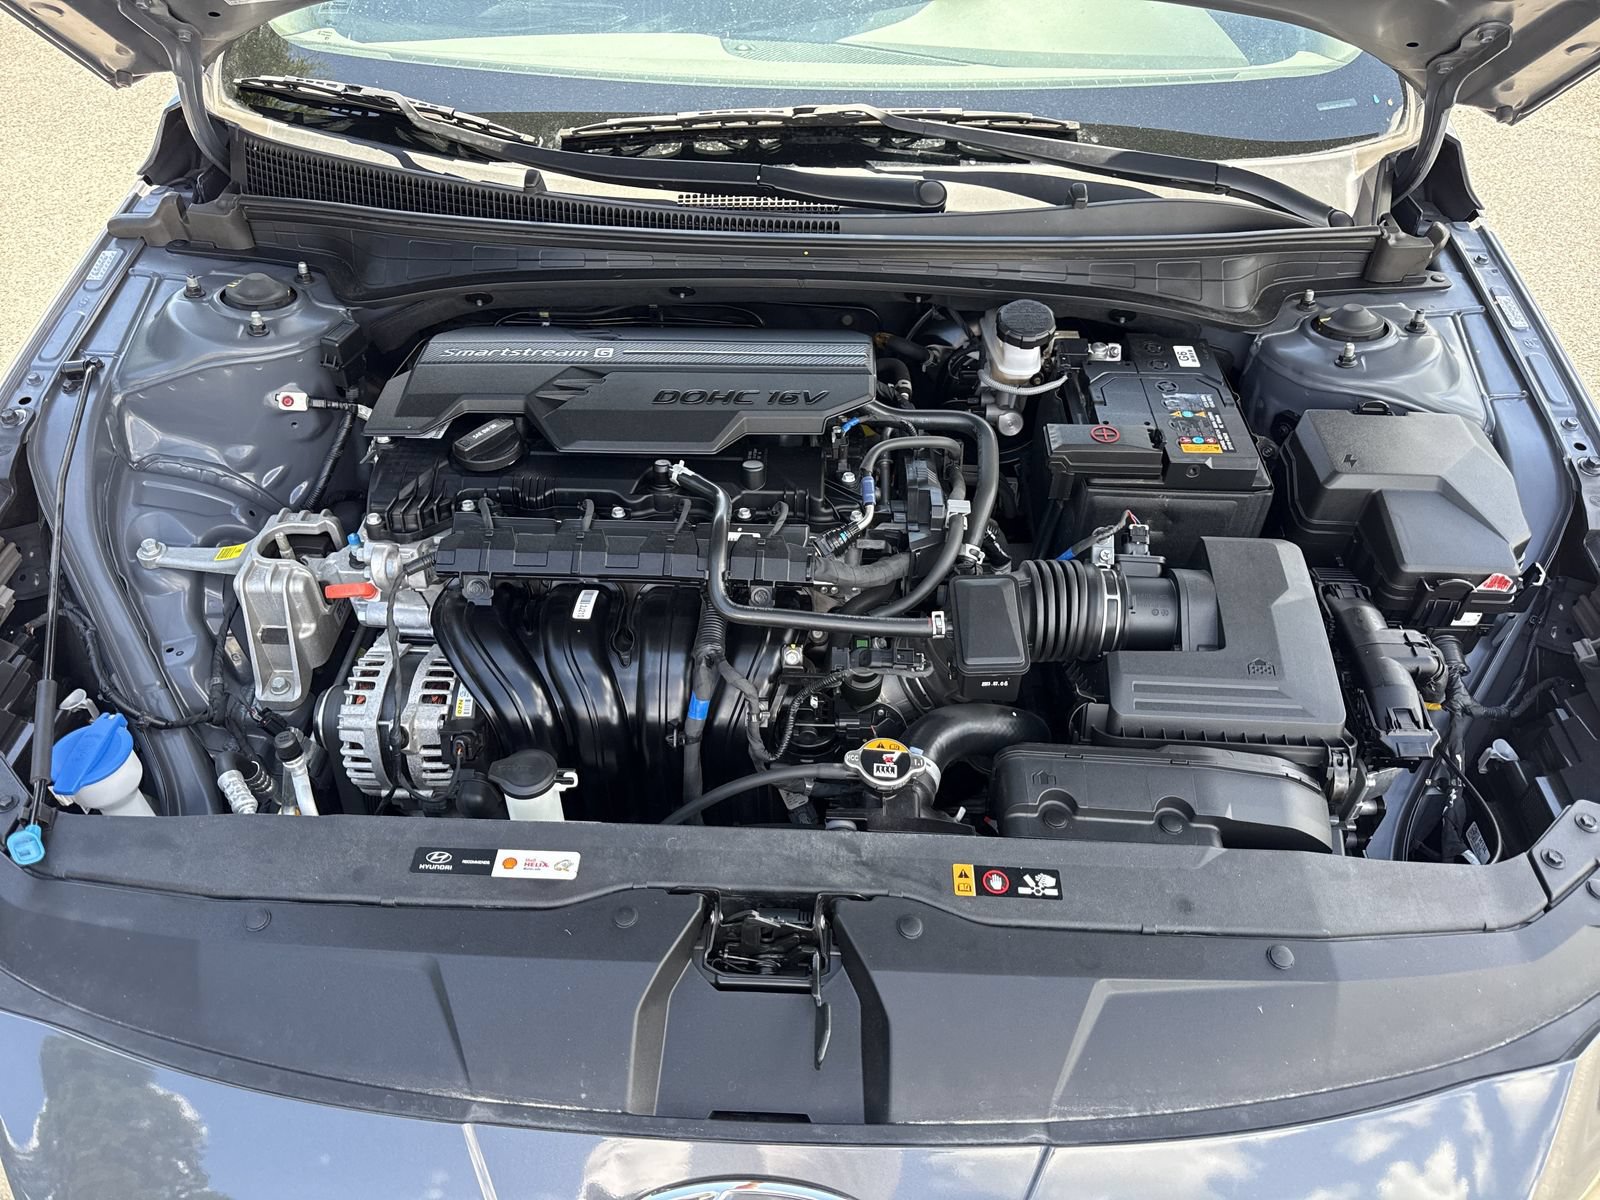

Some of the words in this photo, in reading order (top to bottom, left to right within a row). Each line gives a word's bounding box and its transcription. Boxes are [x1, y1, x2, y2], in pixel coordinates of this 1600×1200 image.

[440, 347, 589, 358] Smartstream
[652, 388, 760, 406] DOHC
[767, 389, 830, 405] 16V
[418, 862, 453, 871] HYUNDAI
